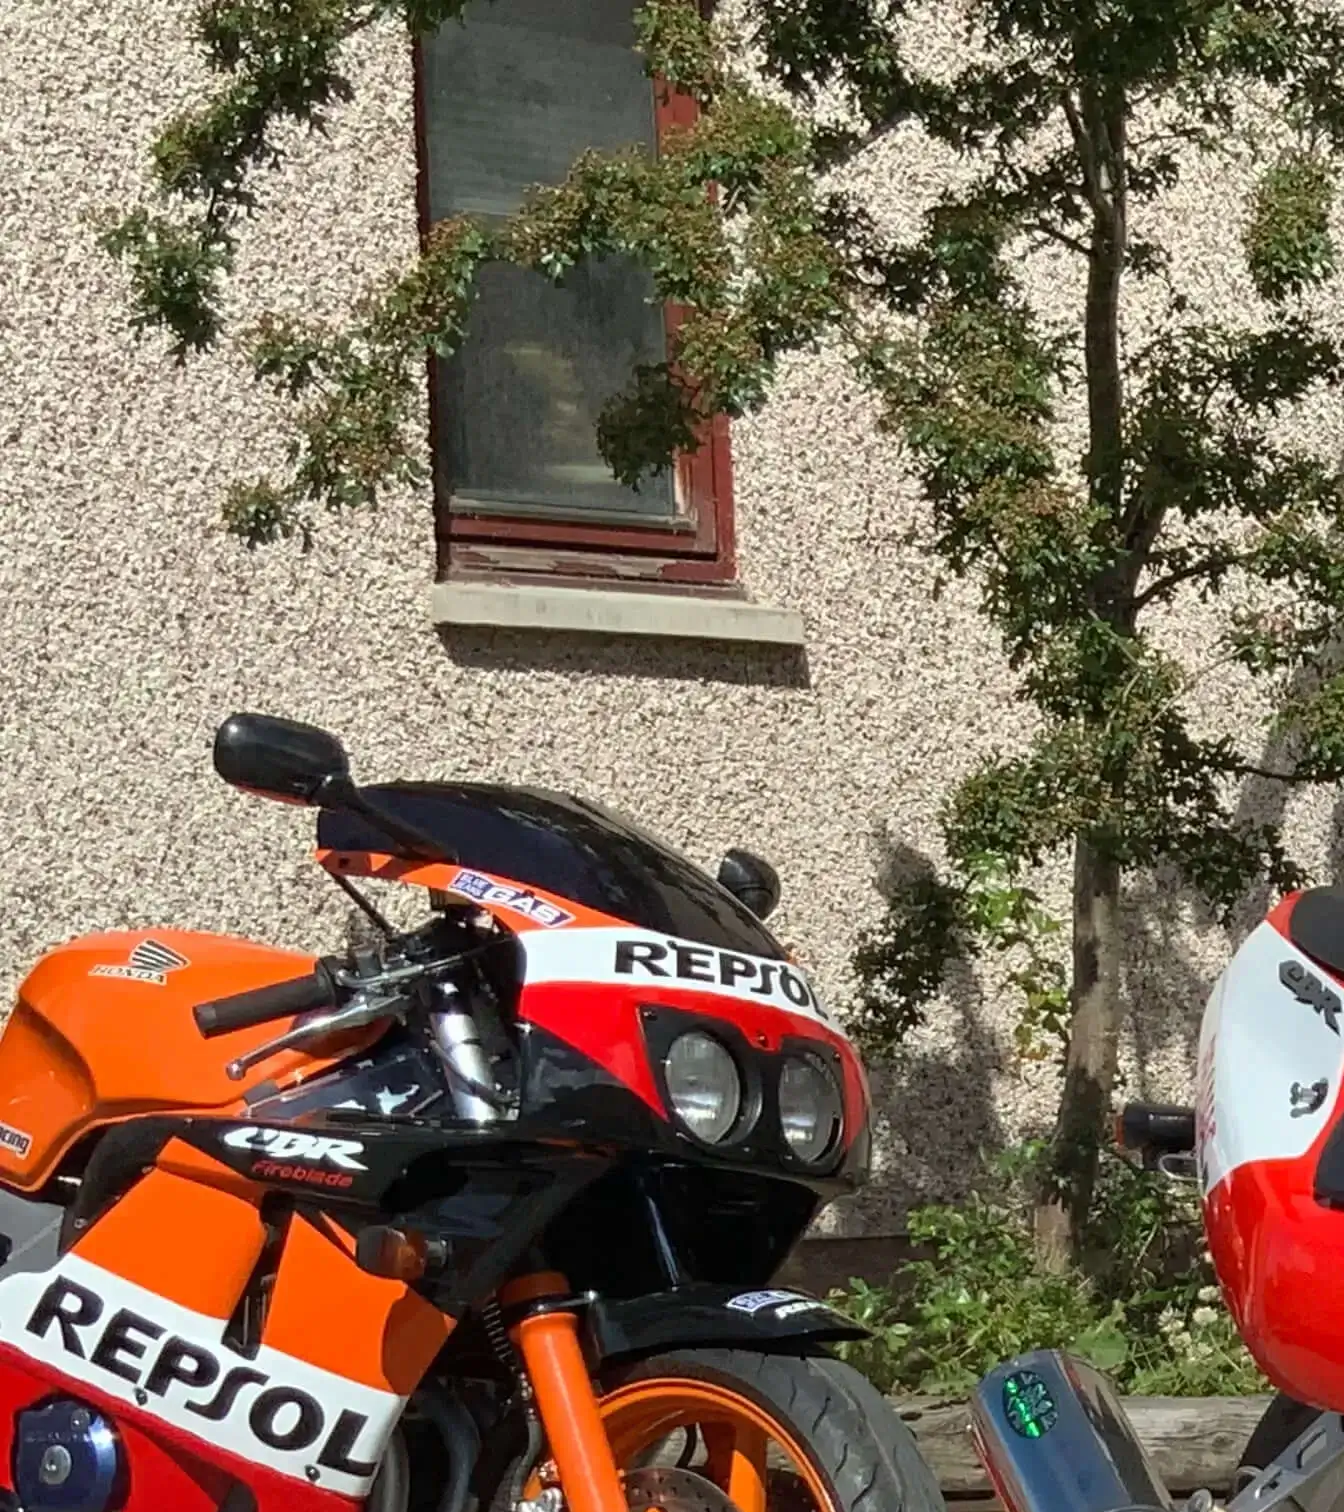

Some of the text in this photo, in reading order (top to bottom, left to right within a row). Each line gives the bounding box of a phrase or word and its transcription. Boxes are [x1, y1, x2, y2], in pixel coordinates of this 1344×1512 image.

[482, 885, 561, 923] GAS
[614, 940, 829, 1021] REPSOL
[223, 1126, 369, 1171] CBR
[251, 1159, 353, 1188] Fireblade
[25, 1275, 378, 1477] REPSOL
